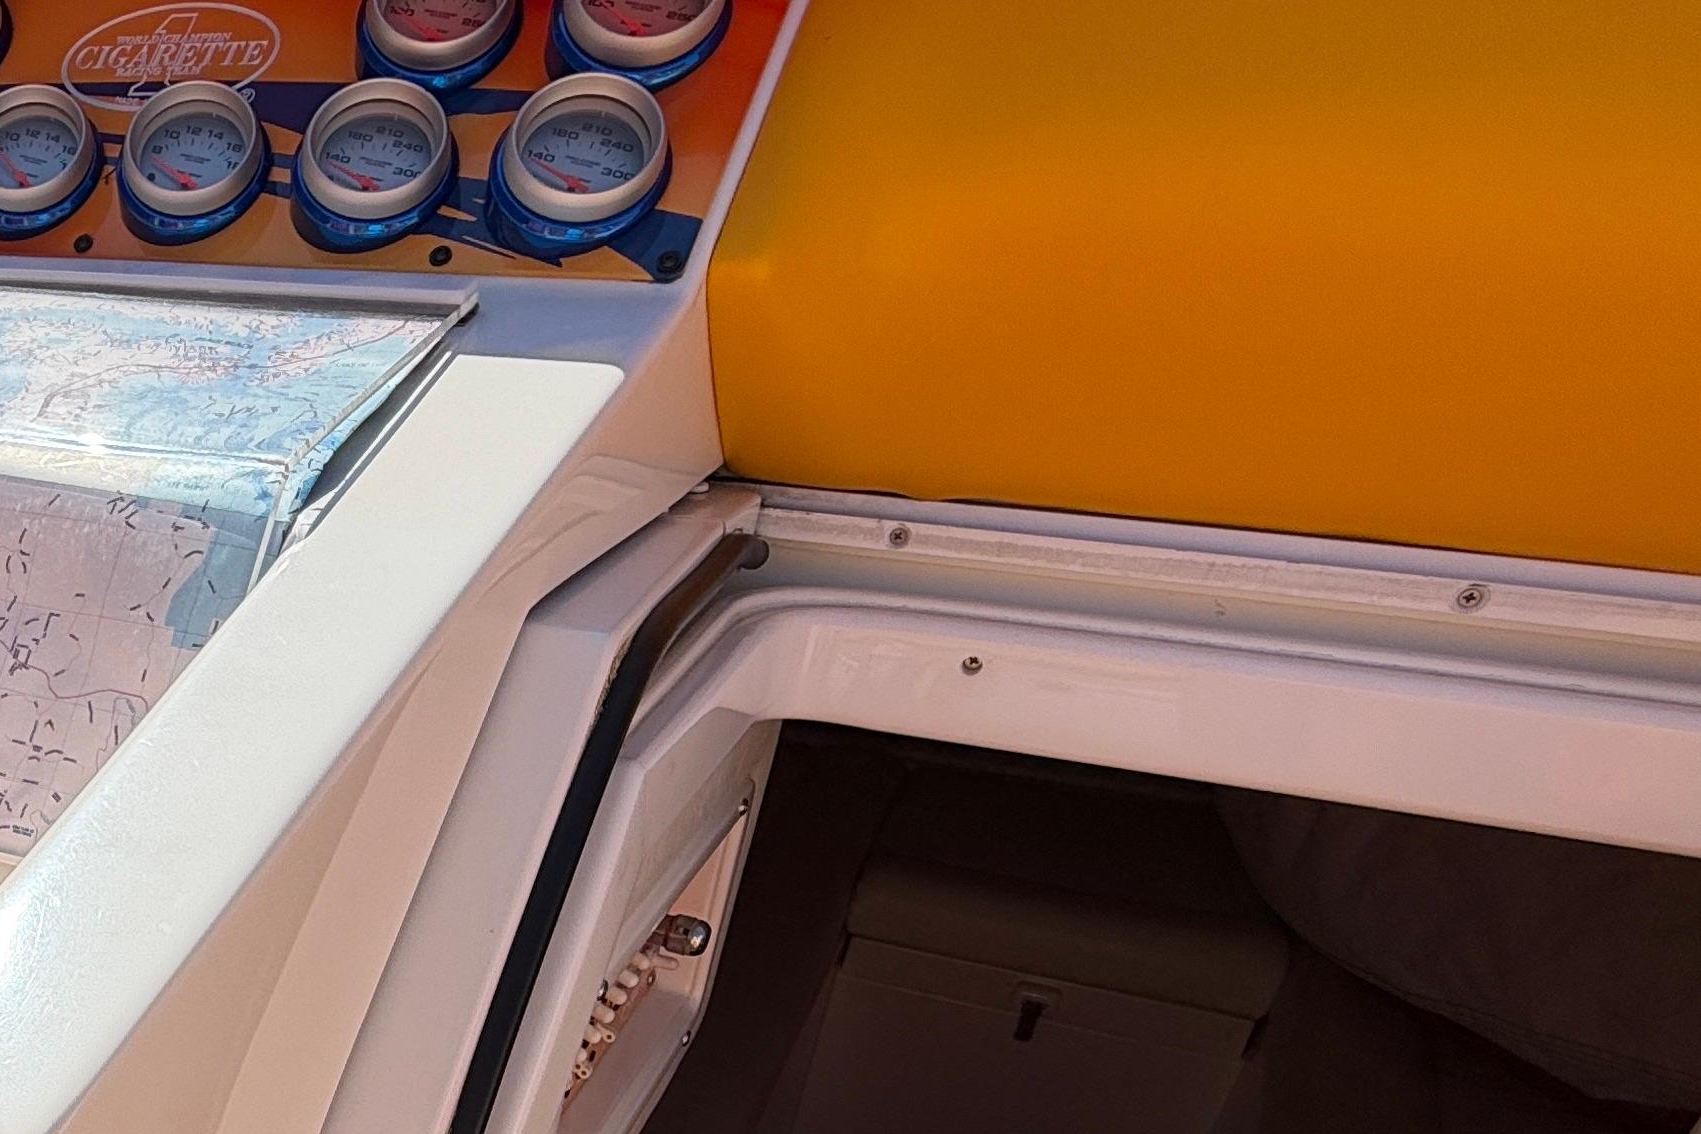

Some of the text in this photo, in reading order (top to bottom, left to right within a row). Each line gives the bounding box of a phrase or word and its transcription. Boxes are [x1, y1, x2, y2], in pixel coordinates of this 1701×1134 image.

[116, 32, 233, 45] WORLD CHAMPION
[75, 40, 269, 69] CIGARETTE
[115, 64, 203, 78] RACING TEAM
[4, 130, 21, 142] 10
[25, 128, 42, 140] 12
[45, 132, 61, 144] 14
[163, 128, 181, 140] 10
[185, 125, 203, 137] 12
[207, 129, 224, 141] 14
[325, 151, 351, 165] 140
[347, 129, 374, 143] 180
[374, 125, 405, 138] 210
[391, 139, 424, 153] 240
[527, 149, 555, 163] 140
[551, 127, 580, 141] 180
[581, 122, 613, 137] 210
[599, 137, 635, 153] 240
